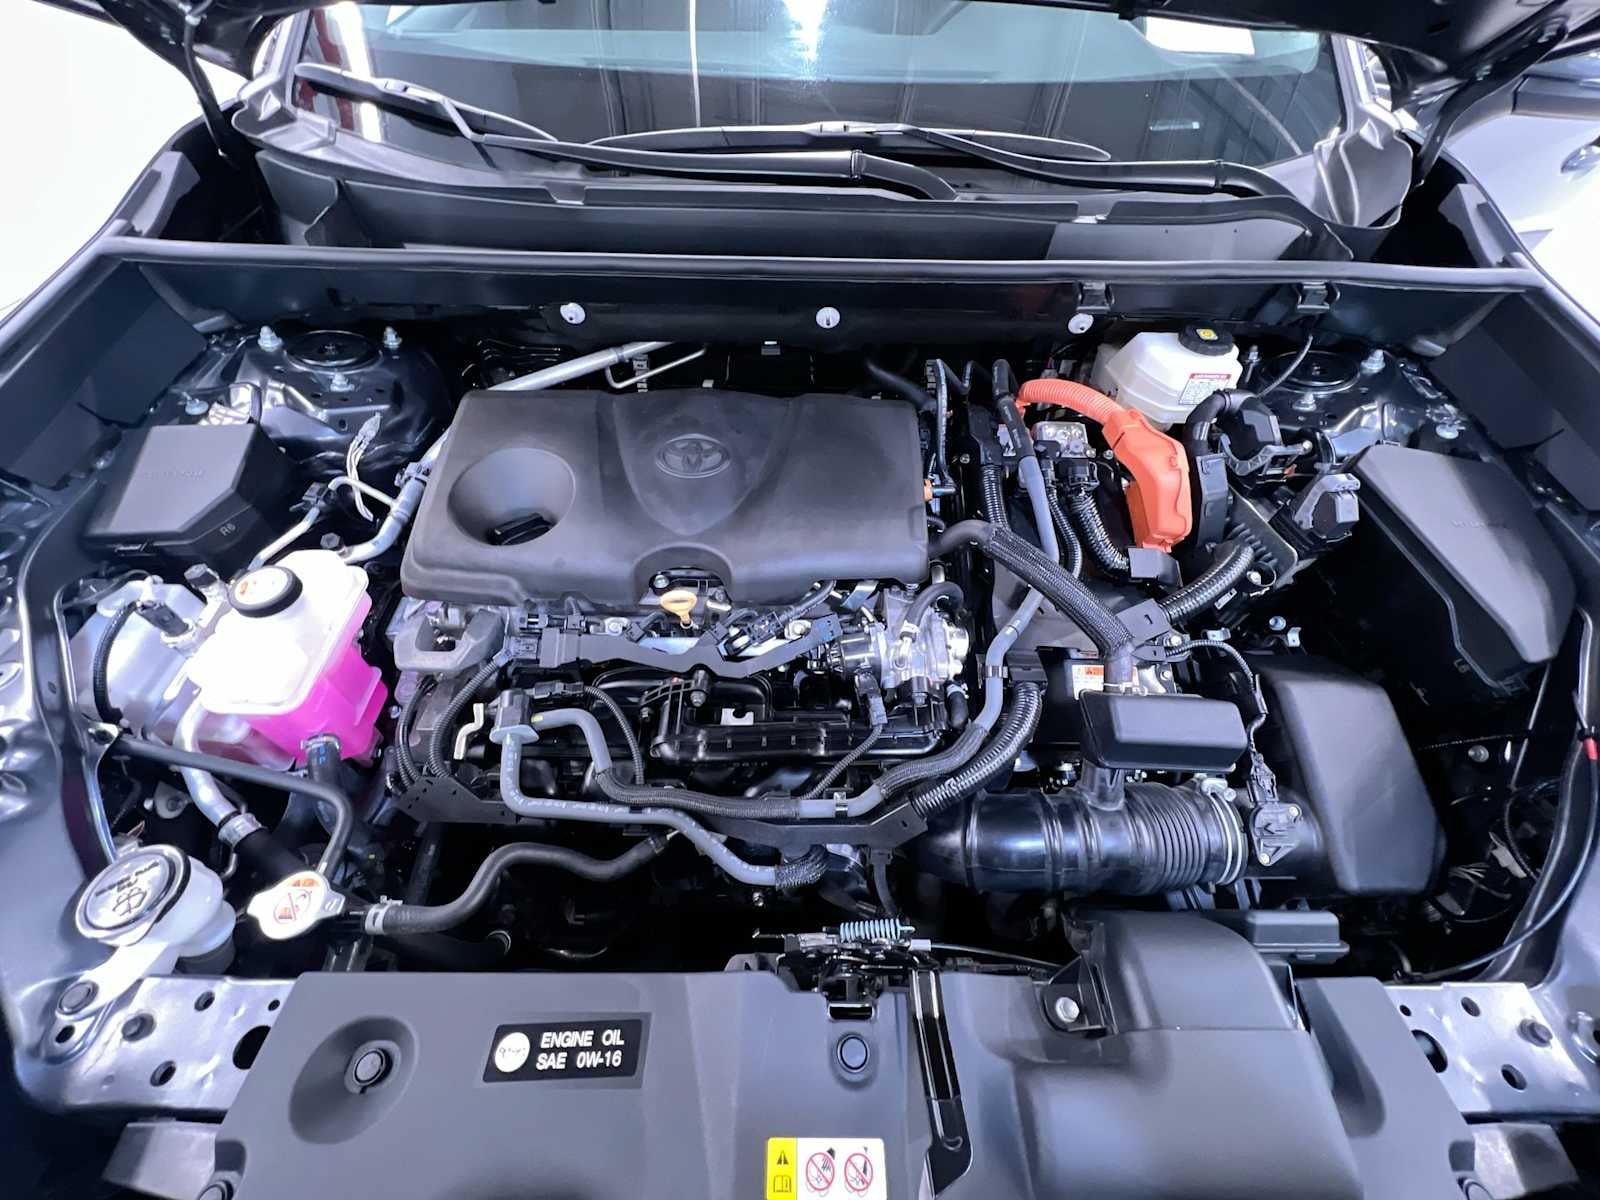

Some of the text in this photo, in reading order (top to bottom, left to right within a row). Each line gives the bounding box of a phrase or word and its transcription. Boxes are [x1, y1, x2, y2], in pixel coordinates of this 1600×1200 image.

[540, 1029, 625, 1049] ENGINE OIL
[535, 1052, 567, 1071] SAE
[576, 1050, 622, 1068] 0W-16
